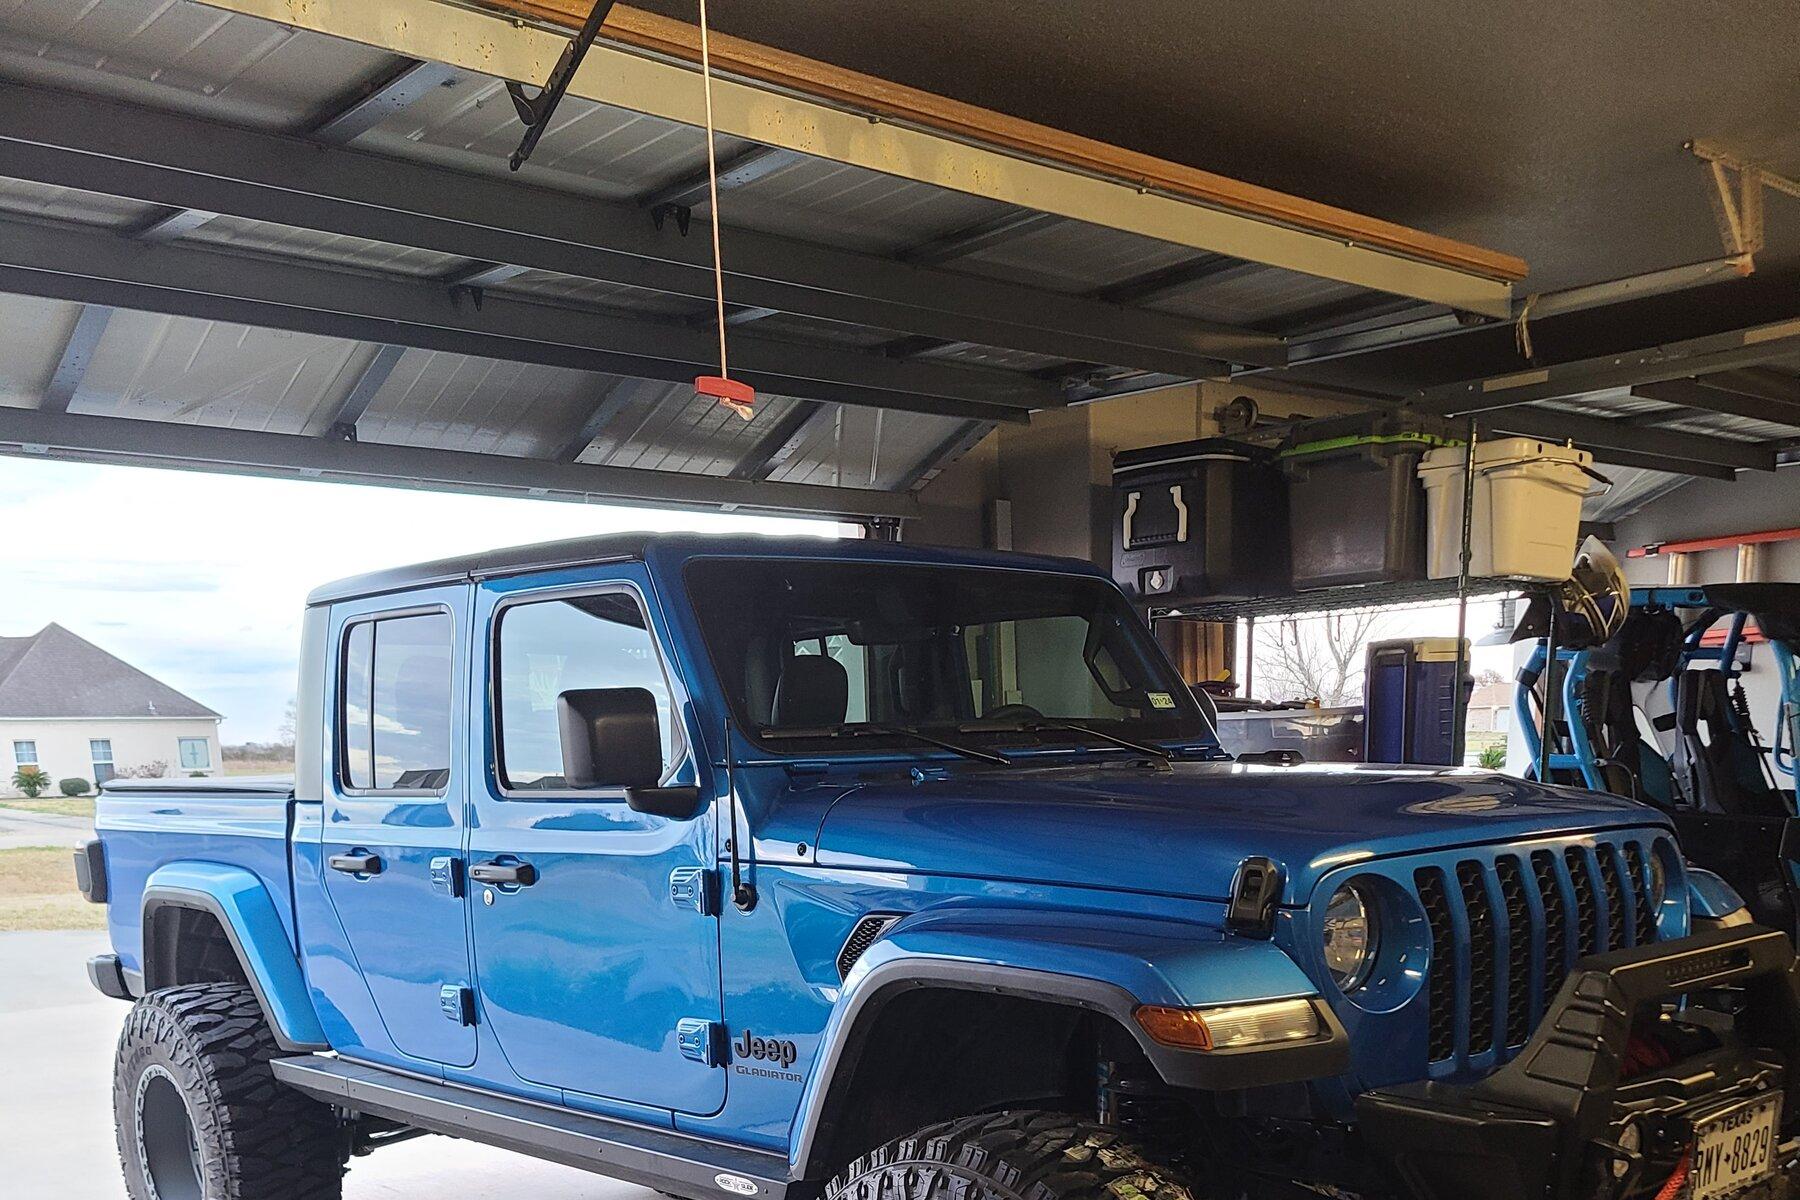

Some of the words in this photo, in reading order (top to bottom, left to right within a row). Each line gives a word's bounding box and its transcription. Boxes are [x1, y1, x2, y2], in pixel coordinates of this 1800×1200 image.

[735, 1029, 797, 1069] Jeep
[736, 1065, 804, 1083] GLADIATOR
[1720, 1109, 1754, 1134] TEXAS
